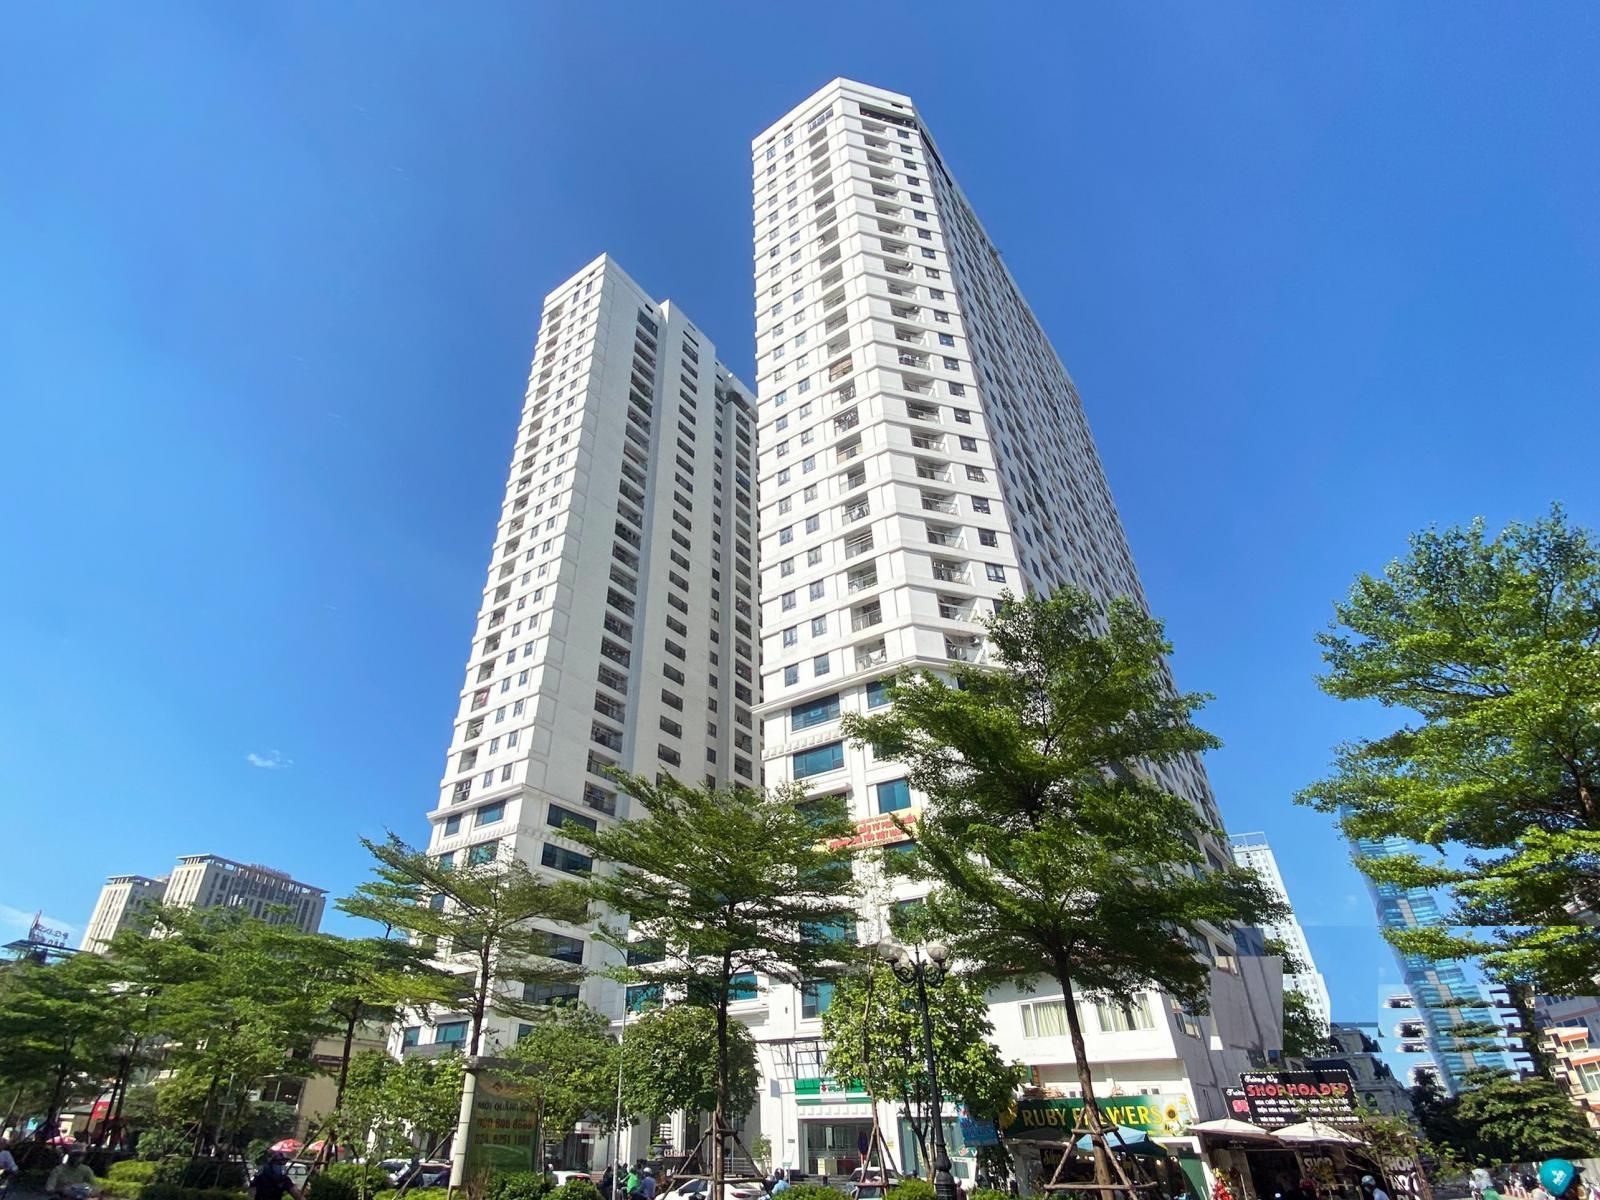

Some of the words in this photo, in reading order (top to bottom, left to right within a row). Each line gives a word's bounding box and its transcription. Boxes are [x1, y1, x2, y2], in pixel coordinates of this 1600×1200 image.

[1246, 1083, 1286, 1097] SHOP
[1286, 1083, 1319, 1097] HOA
[1022, 1107, 1066, 1127] RUBY
[1072, 1104, 1163, 1126] FLWERS
